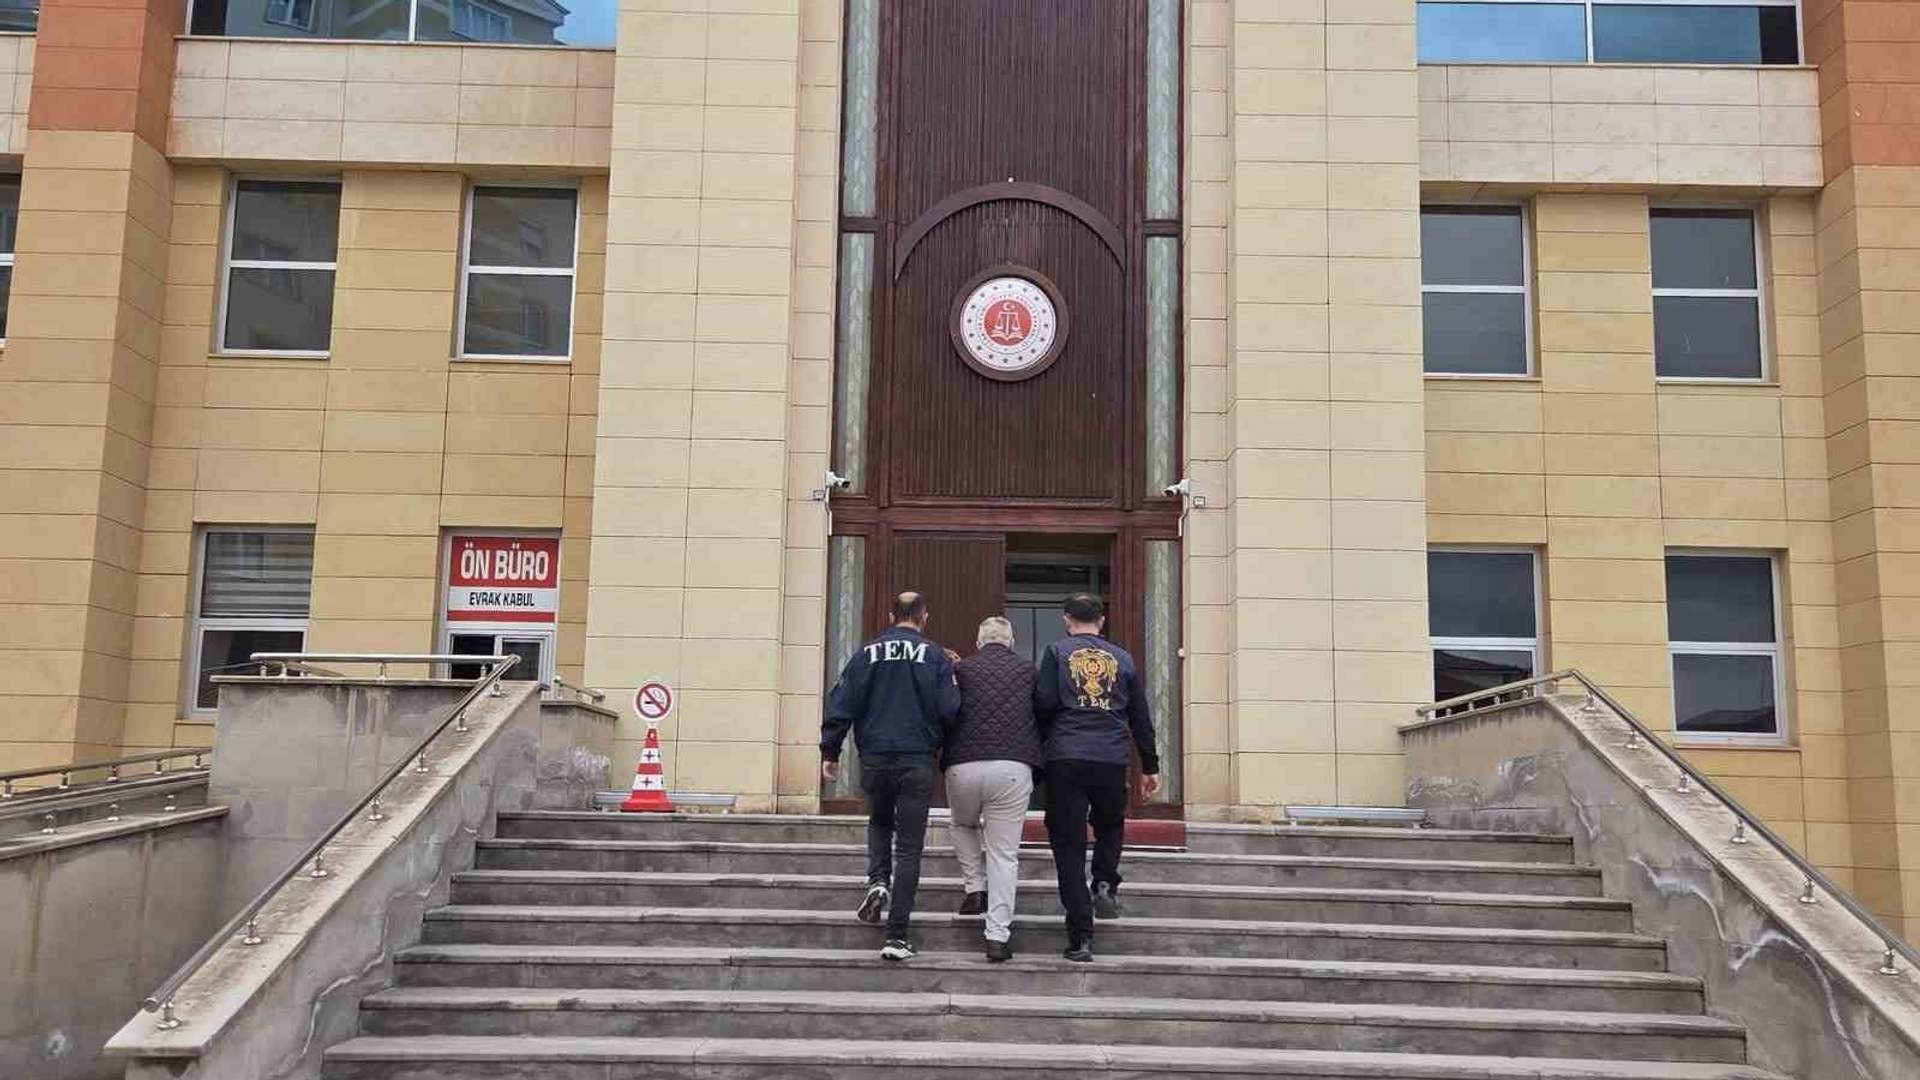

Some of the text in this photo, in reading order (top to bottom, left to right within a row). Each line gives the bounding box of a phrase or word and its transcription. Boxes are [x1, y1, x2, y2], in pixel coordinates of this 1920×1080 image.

[461, 542, 549, 581] ÖN BÜRO
[469, 591, 535, 607] EVRAK KABUL
[864, 640, 930, 665] TEM
[1078, 695, 1112, 710] TEM
